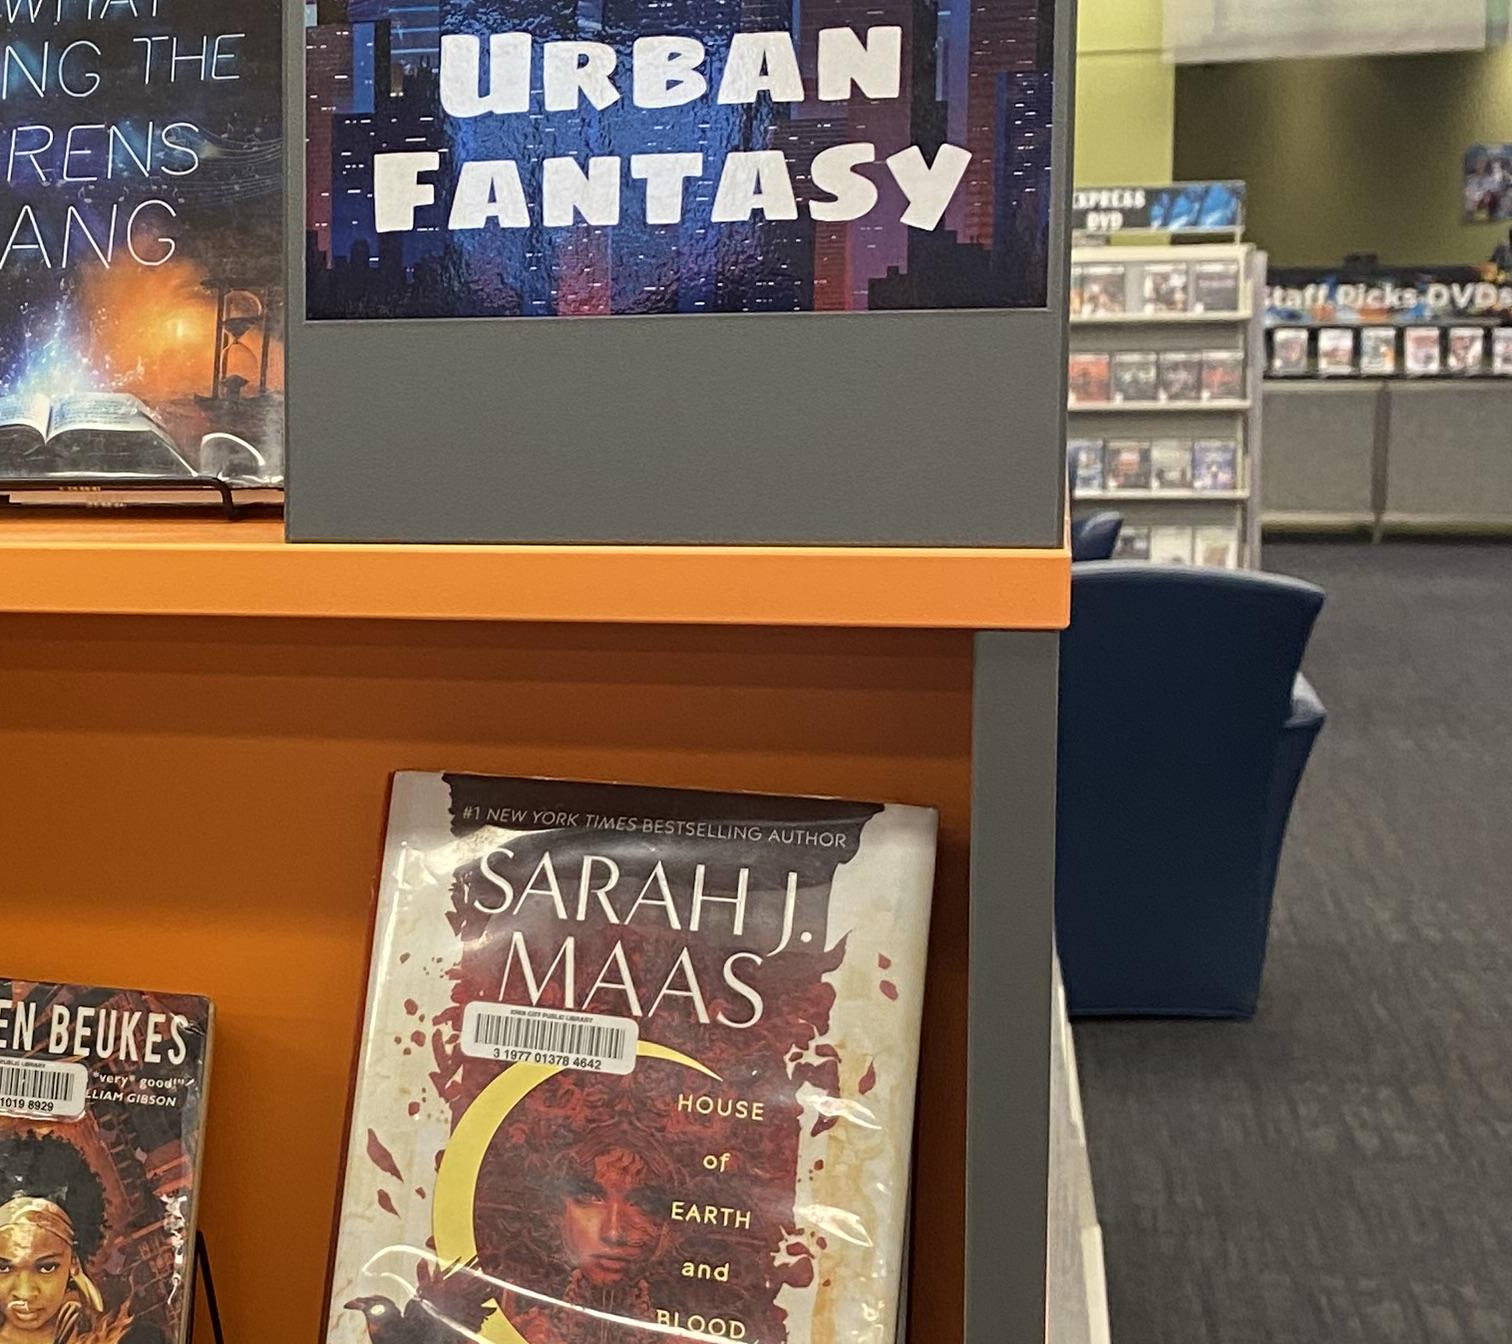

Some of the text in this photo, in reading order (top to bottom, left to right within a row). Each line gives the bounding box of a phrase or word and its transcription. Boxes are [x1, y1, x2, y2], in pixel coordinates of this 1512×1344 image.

[132, 33, 246, 85] THE
[440, 25, 902, 119] URBAN
[374, 142, 973, 234] FANTASY
[1086, 210, 1123, 231] DVD
[1336, 283, 1417, 307] Picks
[462, 805, 848, 849] #1 NEW YORK TIMES BESTSELLING AUTHOR
[473, 847, 813, 957] SARAH J.
[498, 930, 764, 1030] MAAS
[48, 1004, 188, 1065] BEUKES
[493, 1048, 602, 1070] 3 1977 01378 4642
[28, 1100, 54, 1112] 8929
[127, 1093, 177, 1107] GIBSON
[677, 1094, 765, 1121] HOUSE
[703, 1153, 731, 1173] of
[671, 1201, 751, 1230] EARTH
[681, 1261, 730, 1282] and
[655, 1309, 746, 1339] BLOOD
